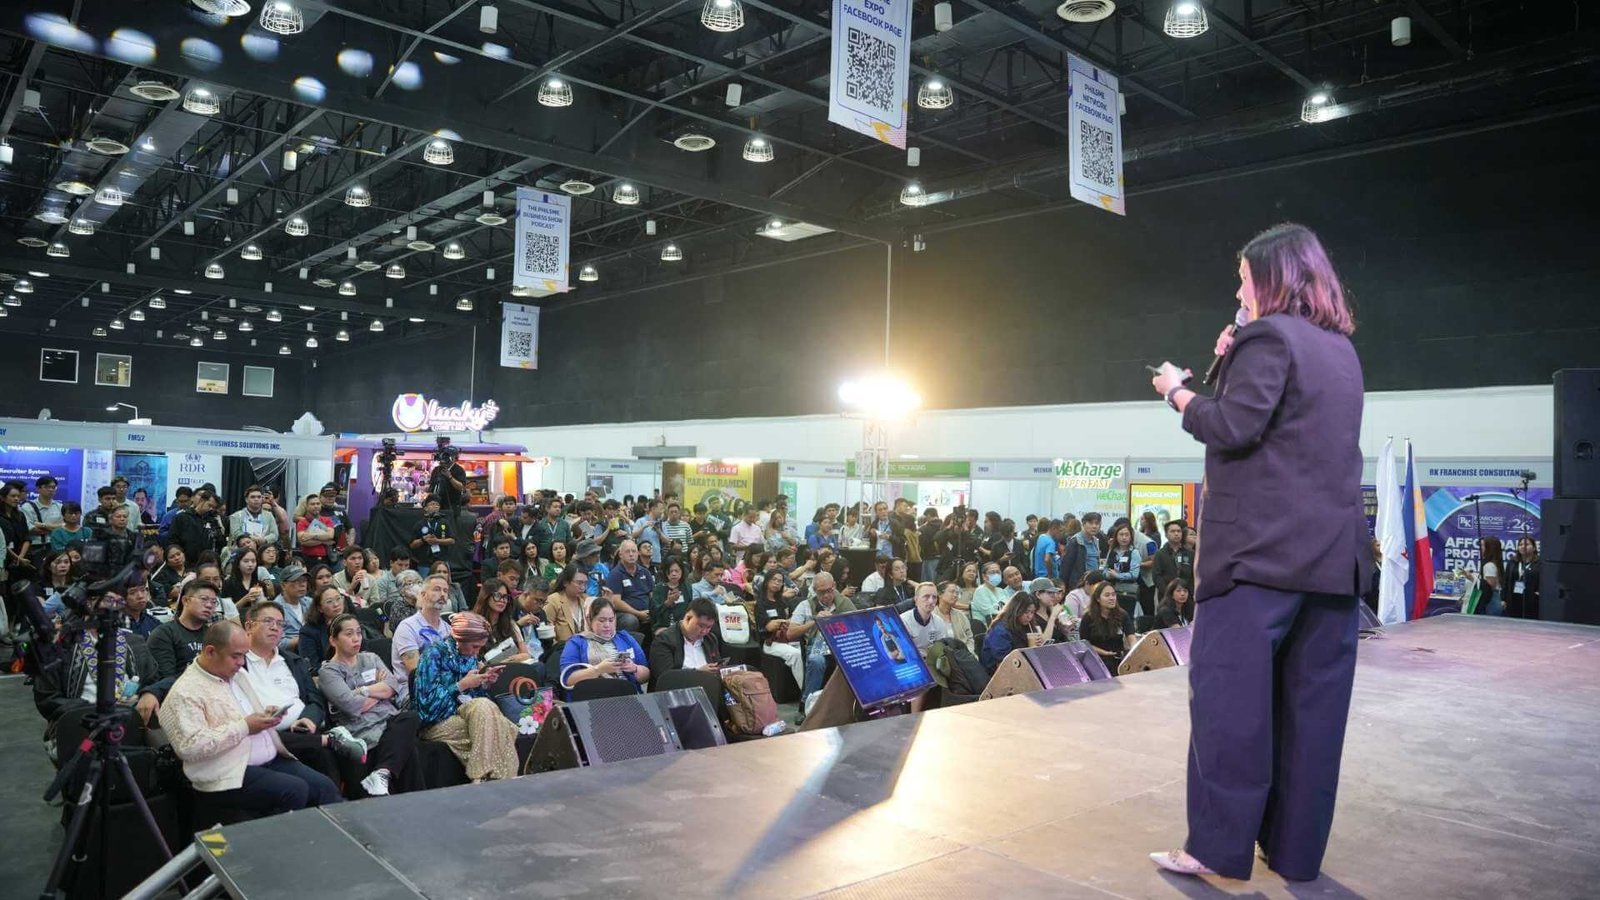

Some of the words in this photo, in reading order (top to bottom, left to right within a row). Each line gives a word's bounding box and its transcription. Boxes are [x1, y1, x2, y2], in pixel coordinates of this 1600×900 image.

[864, 0, 885, 15] EXPO
[843, 4, 883, 29] FACEBOOK
[884, 21, 903, 37] PAGE
[1082, 94, 1107, 110] NETWORK
[1075, 101, 1101, 119] FACEBOOK
[522, 211, 548, 221] BUSINESS
[547, 215, 563, 223] SHOW
[531, 220, 555, 230] PODCAST
[127, 433, 146, 442] FM52
[210, 439, 238, 448] BUSINESS
[238, 441, 269, 450] SOLUTIONS
[28, 468, 50, 476] System
[179, 463, 206, 473] RDR
[1055, 462, 1122, 480] WeCharge
[1429, 468, 1439, 476] RK
[1440, 468, 1477, 477] FRANCHISE
[717, 479, 748, 489] RAMEN
[1096, 490, 1127, 504] WeCharg
[724, 615, 741, 624] SME
